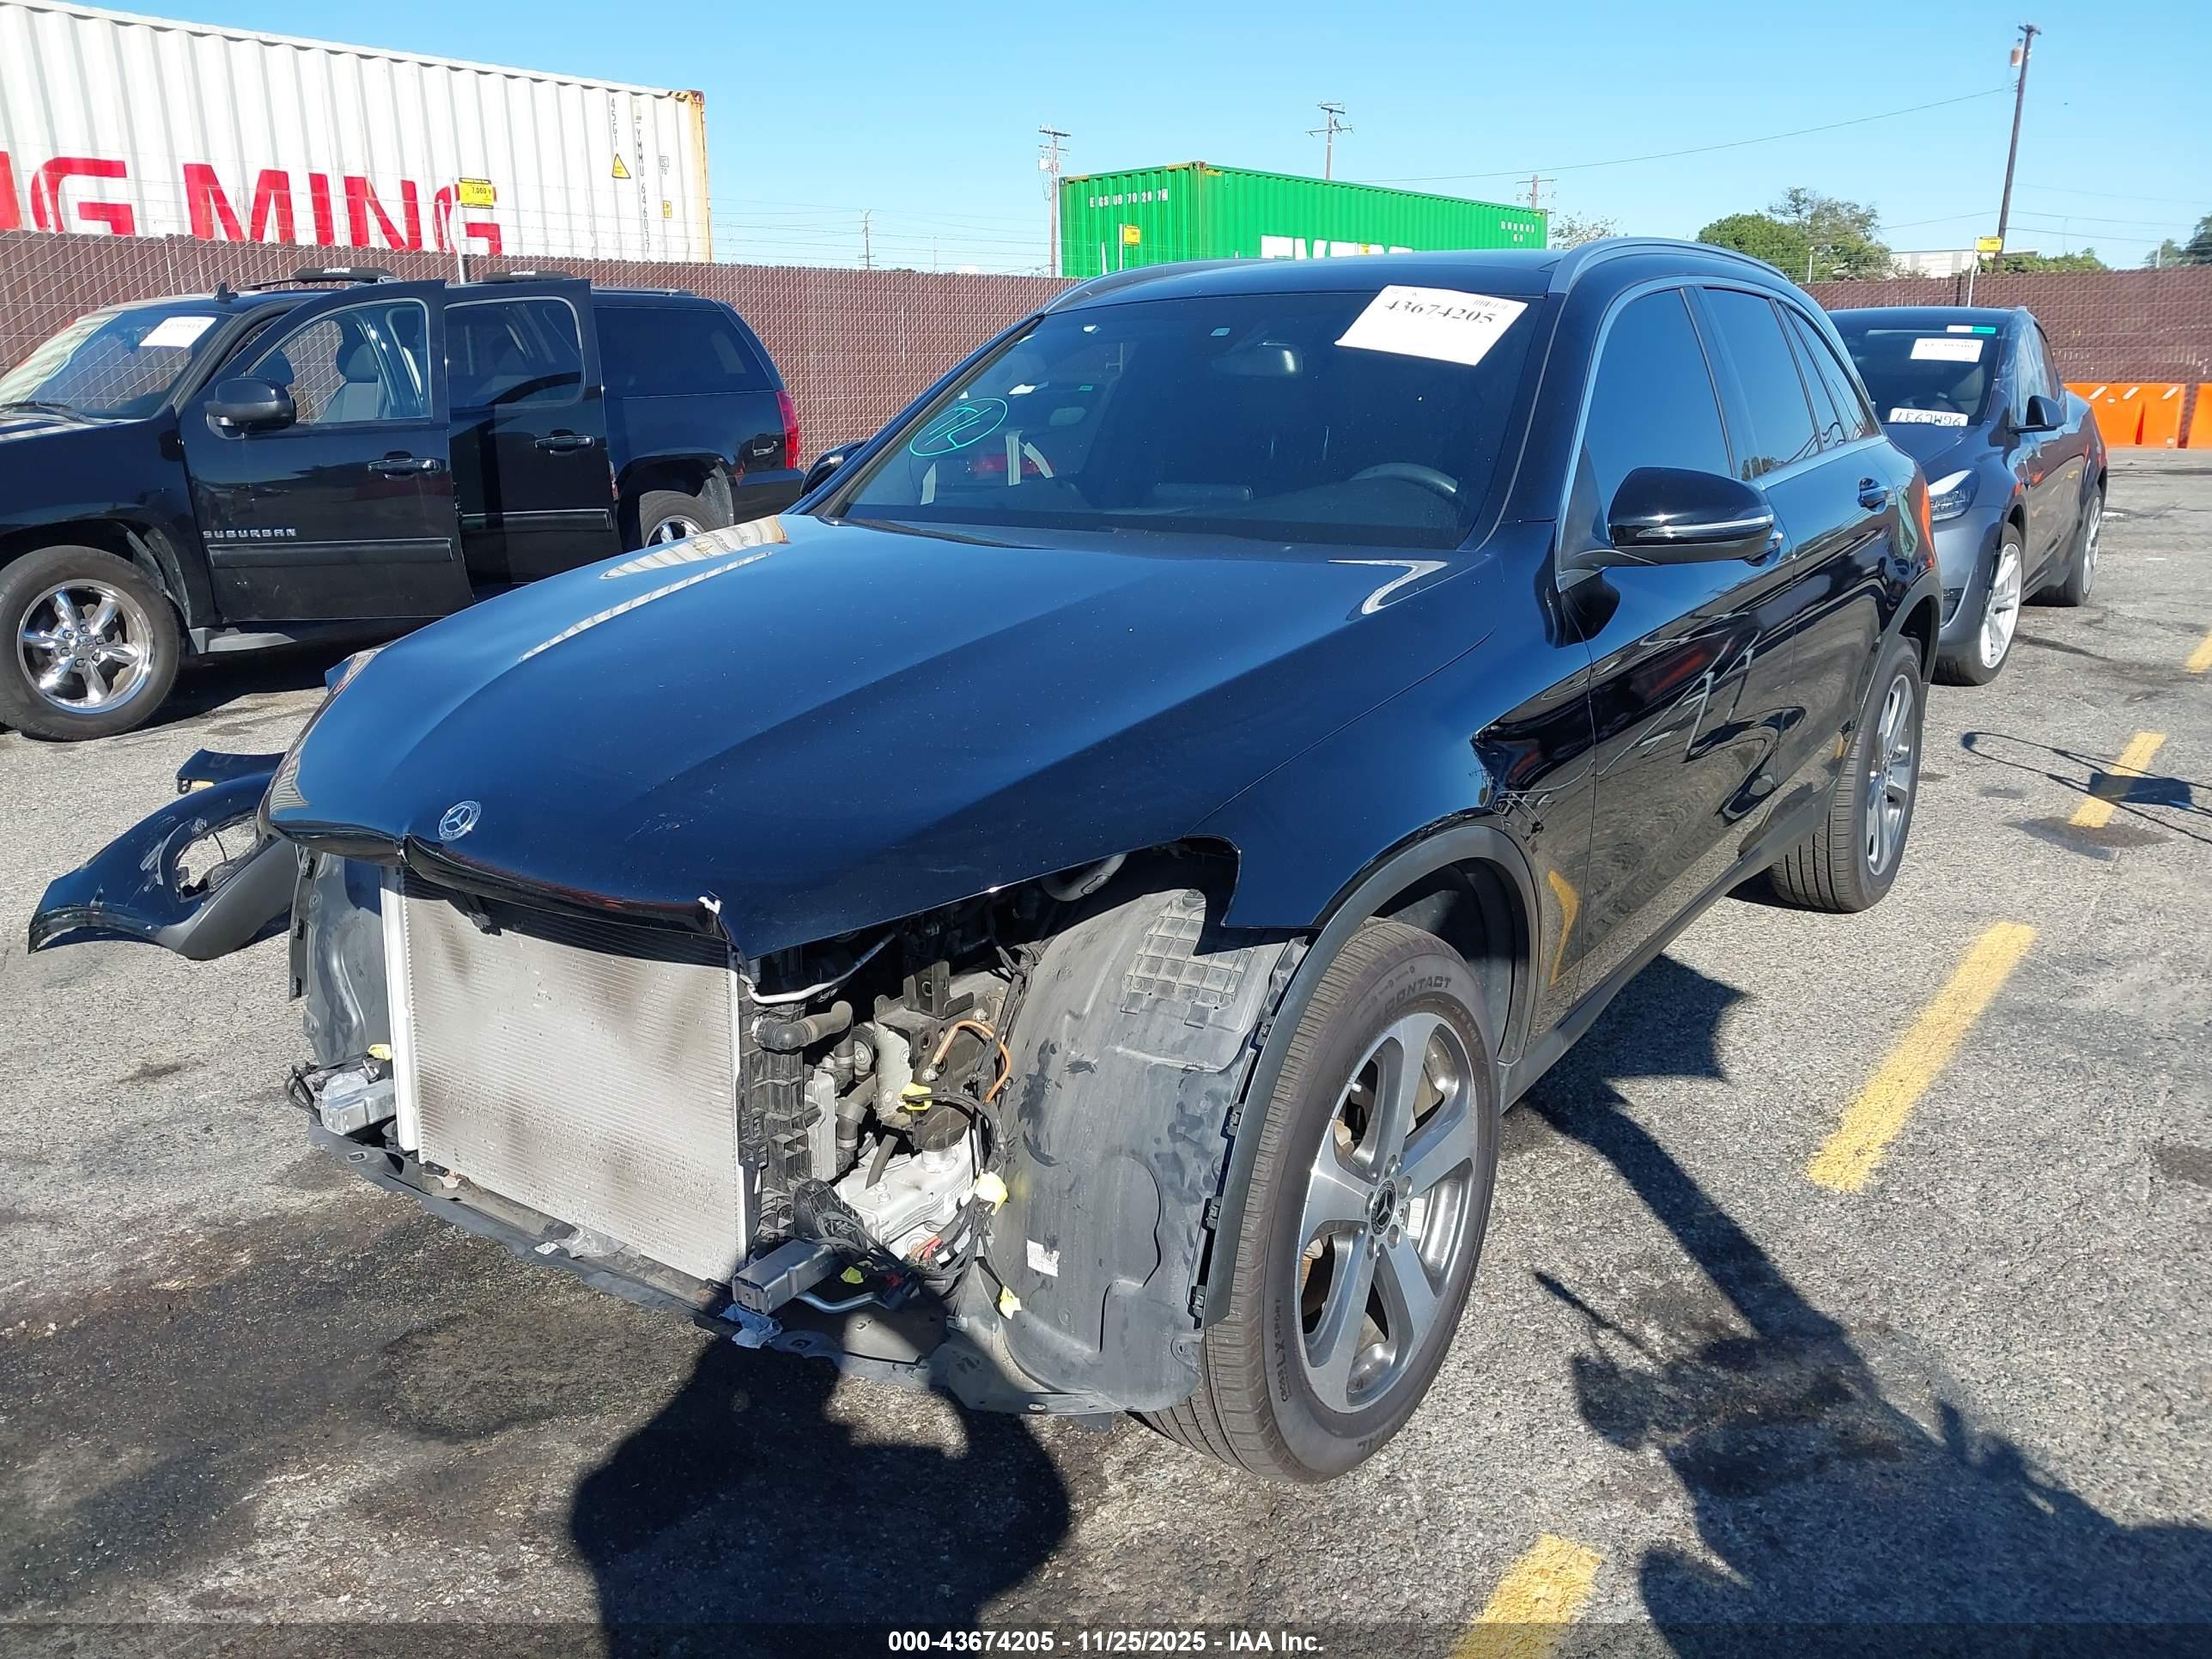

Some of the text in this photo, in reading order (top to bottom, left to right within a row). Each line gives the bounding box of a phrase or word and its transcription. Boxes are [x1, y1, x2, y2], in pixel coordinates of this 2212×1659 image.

[183, 162, 503, 256] MING
[1384, 300, 1497, 324] 43674205
[203, 528, 296, 538] SUBURBAN
